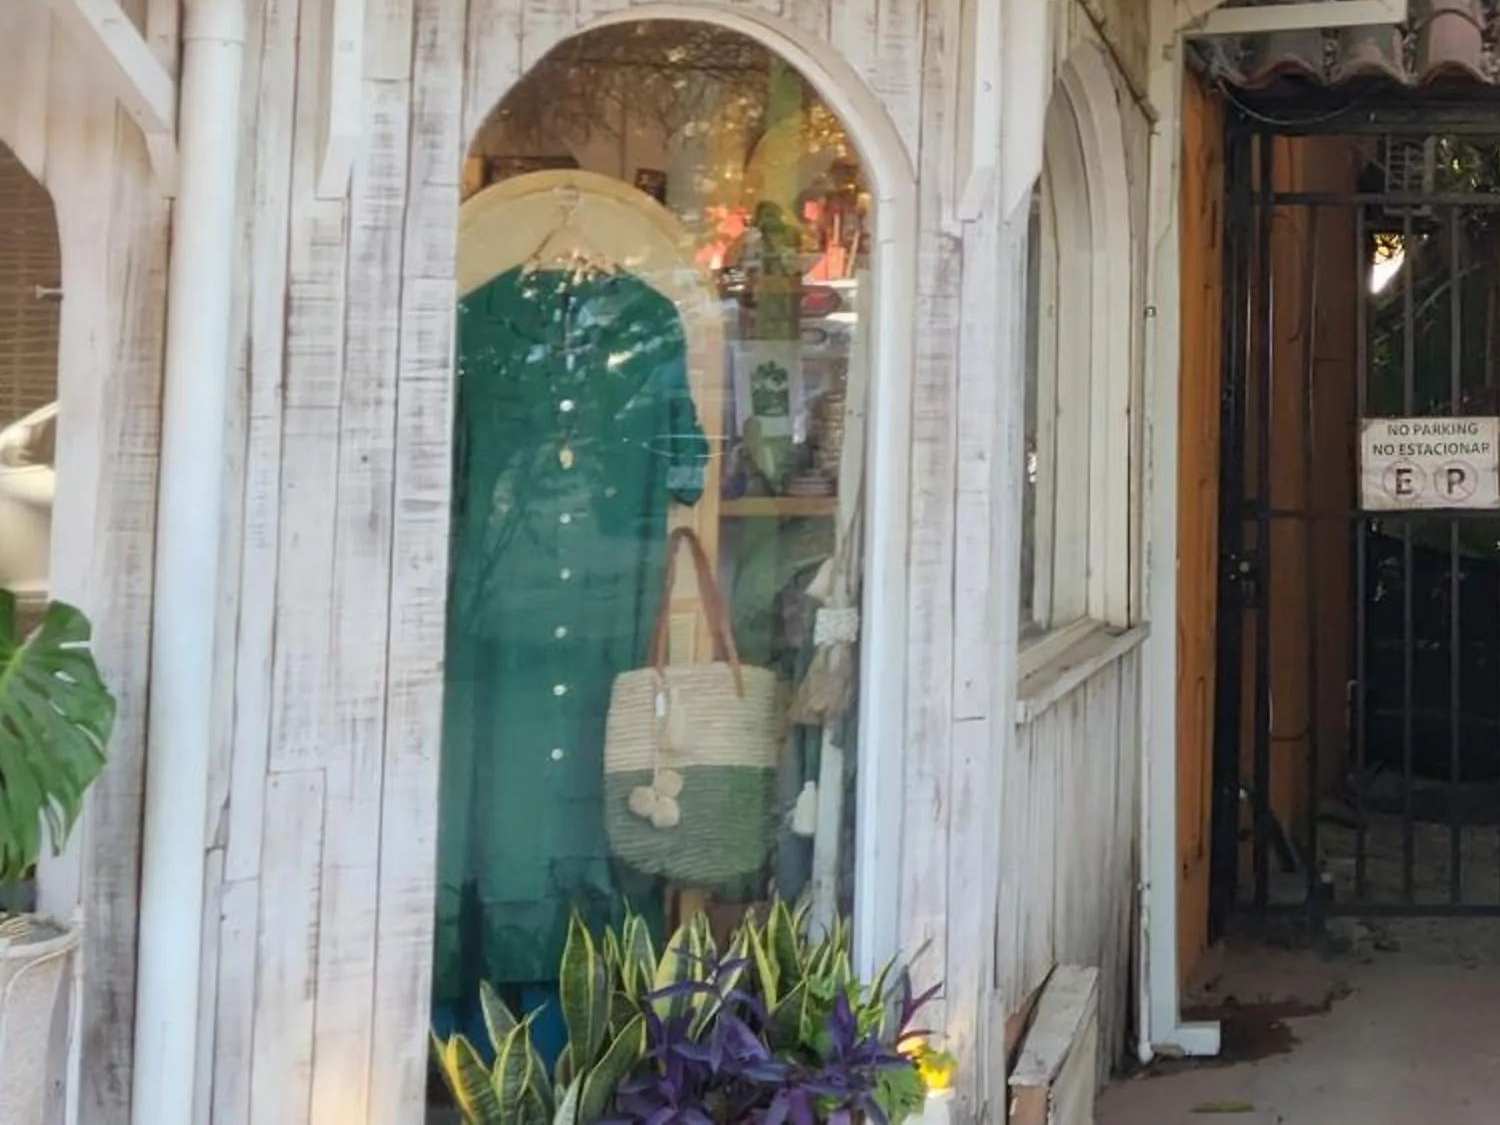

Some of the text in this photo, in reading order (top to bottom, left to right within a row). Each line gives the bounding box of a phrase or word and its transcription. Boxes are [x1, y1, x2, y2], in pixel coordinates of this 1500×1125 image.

[1388, 423, 1478, 436] NO PARKING
[1372, 443, 1395, 456] NO
